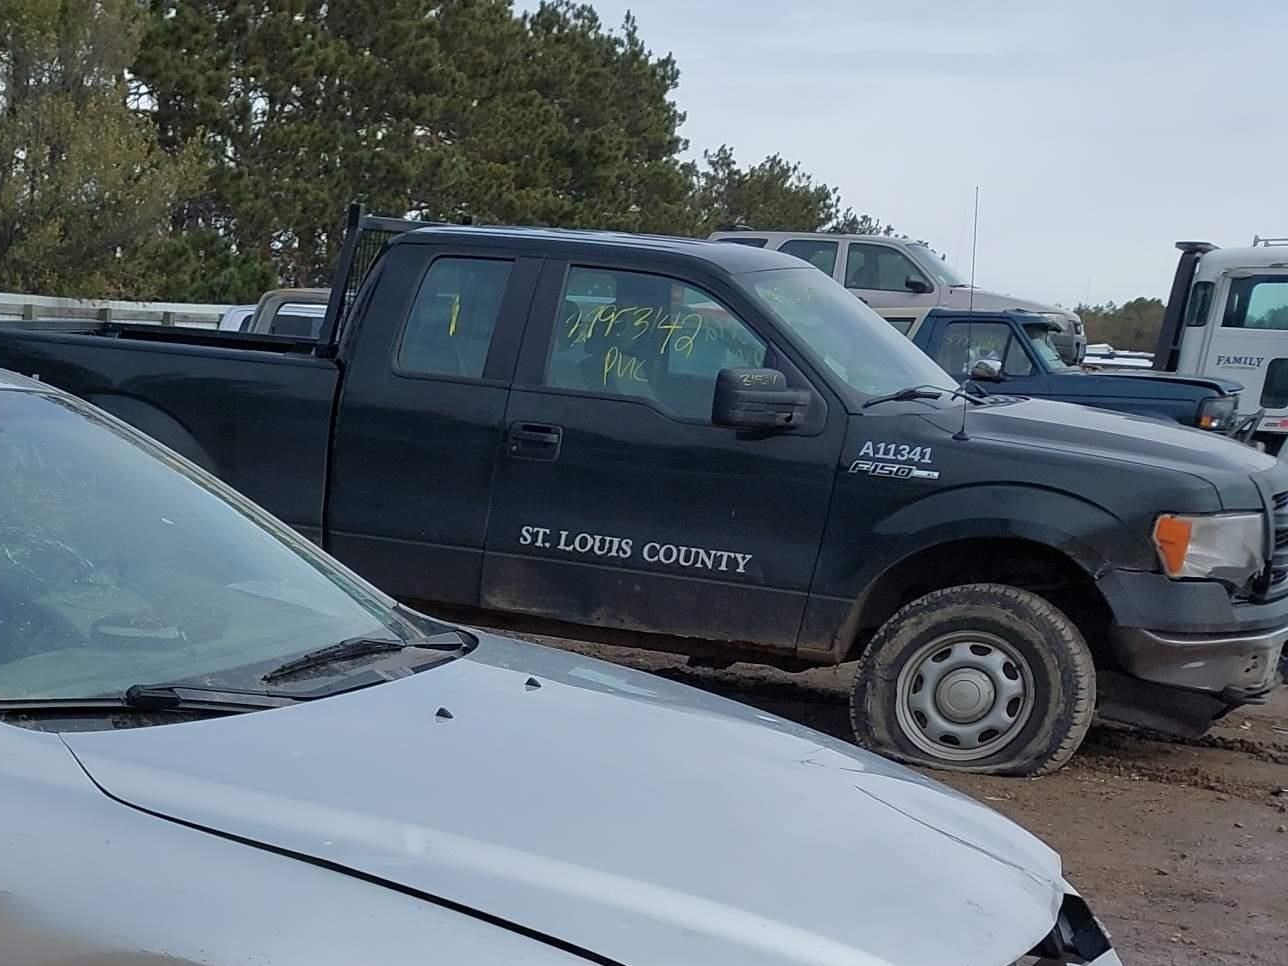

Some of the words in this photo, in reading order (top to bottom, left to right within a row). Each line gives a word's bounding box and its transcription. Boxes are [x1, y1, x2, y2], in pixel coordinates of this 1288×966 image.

[1216, 355, 1264, 367] FAMILY
[858, 441, 932, 463] A11341
[519, 526, 551, 548] ST.
[557, 530, 633, 558] LOUIS
[642, 542, 753, 573] COUNTY
